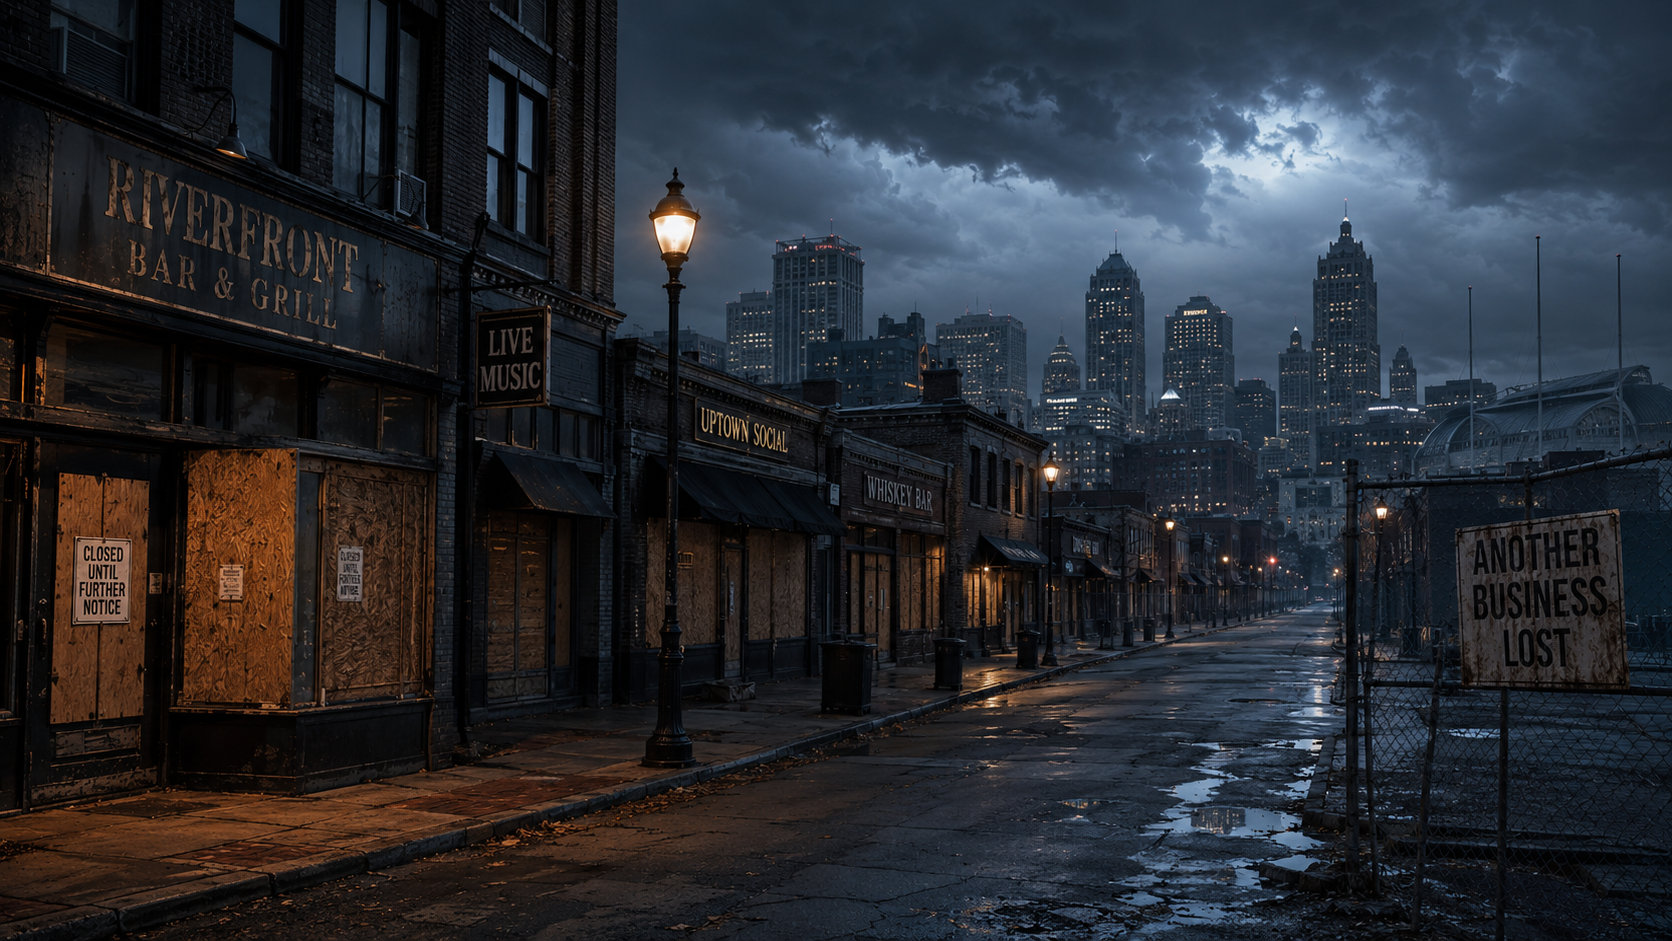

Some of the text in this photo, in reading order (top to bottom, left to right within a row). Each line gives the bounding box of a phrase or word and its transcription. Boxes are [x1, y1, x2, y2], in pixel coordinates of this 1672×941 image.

[104, 155, 359, 293] RIVERFRONT
[127, 239, 337, 329] BAR & GRILL
[487, 326, 534, 357] LIVE
[479, 361, 542, 393] MUSIC
[701, 406, 789, 453] UPTOWN SOCIAL
[867, 475, 933, 511] WHISKEY BAR
[84, 545, 123, 562] CLOSED
[1473, 528, 1601, 575] ANOTHER
[79, 582, 126, 597] FURTHER
[88, 564, 118, 579] UNTIL
[84, 599, 121, 615] NOTICE
[1473, 576, 1607, 620] BUSINESS
[1504, 628, 1570, 667] LOST
